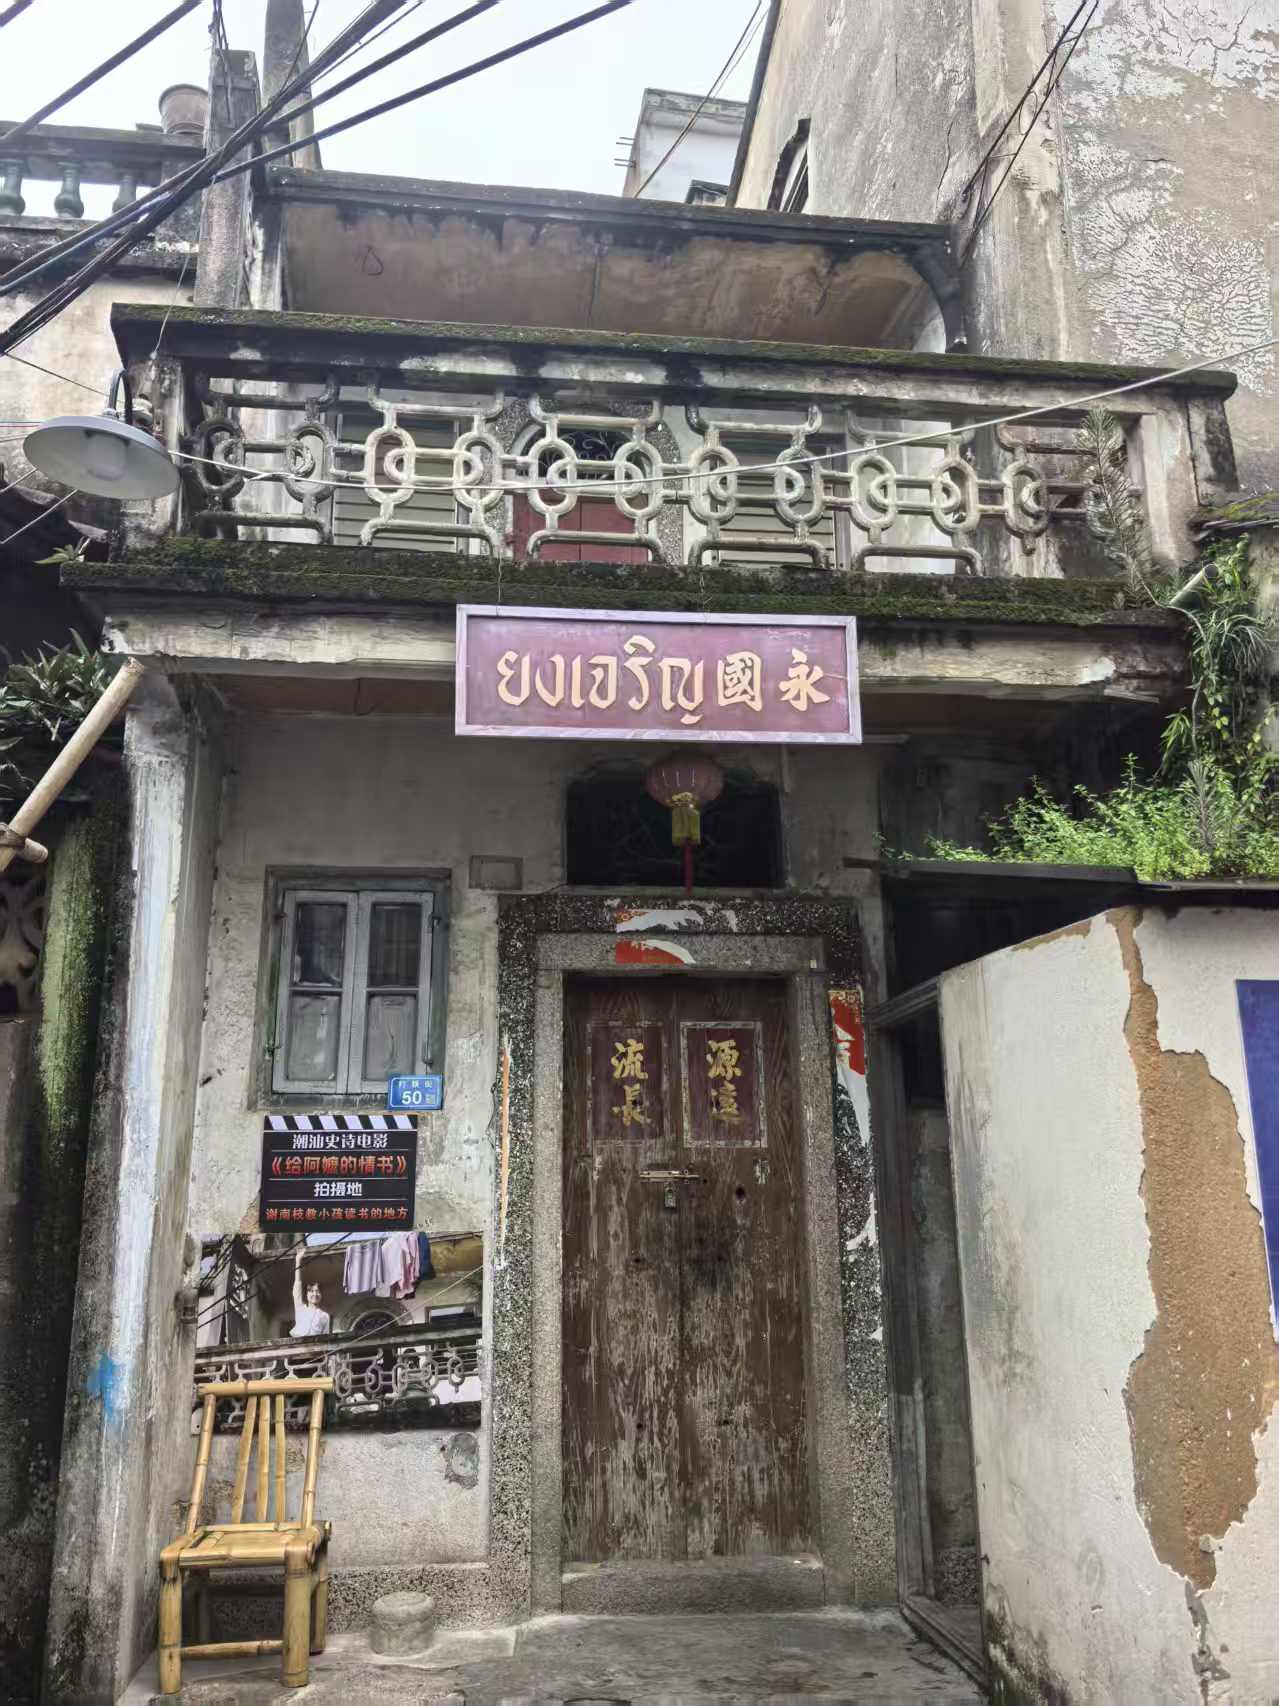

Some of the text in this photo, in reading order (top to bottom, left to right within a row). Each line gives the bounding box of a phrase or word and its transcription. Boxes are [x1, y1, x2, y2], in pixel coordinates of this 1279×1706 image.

[292, 1133, 388, 1149] 潮汕史诗电影
[272, 1155, 407, 1177] 《给阿嬷的情书》
[313, 1181, 363, 1197] 拍摄地
[266, 1207, 409, 1221] 谢南枝教小孩读书的地方
